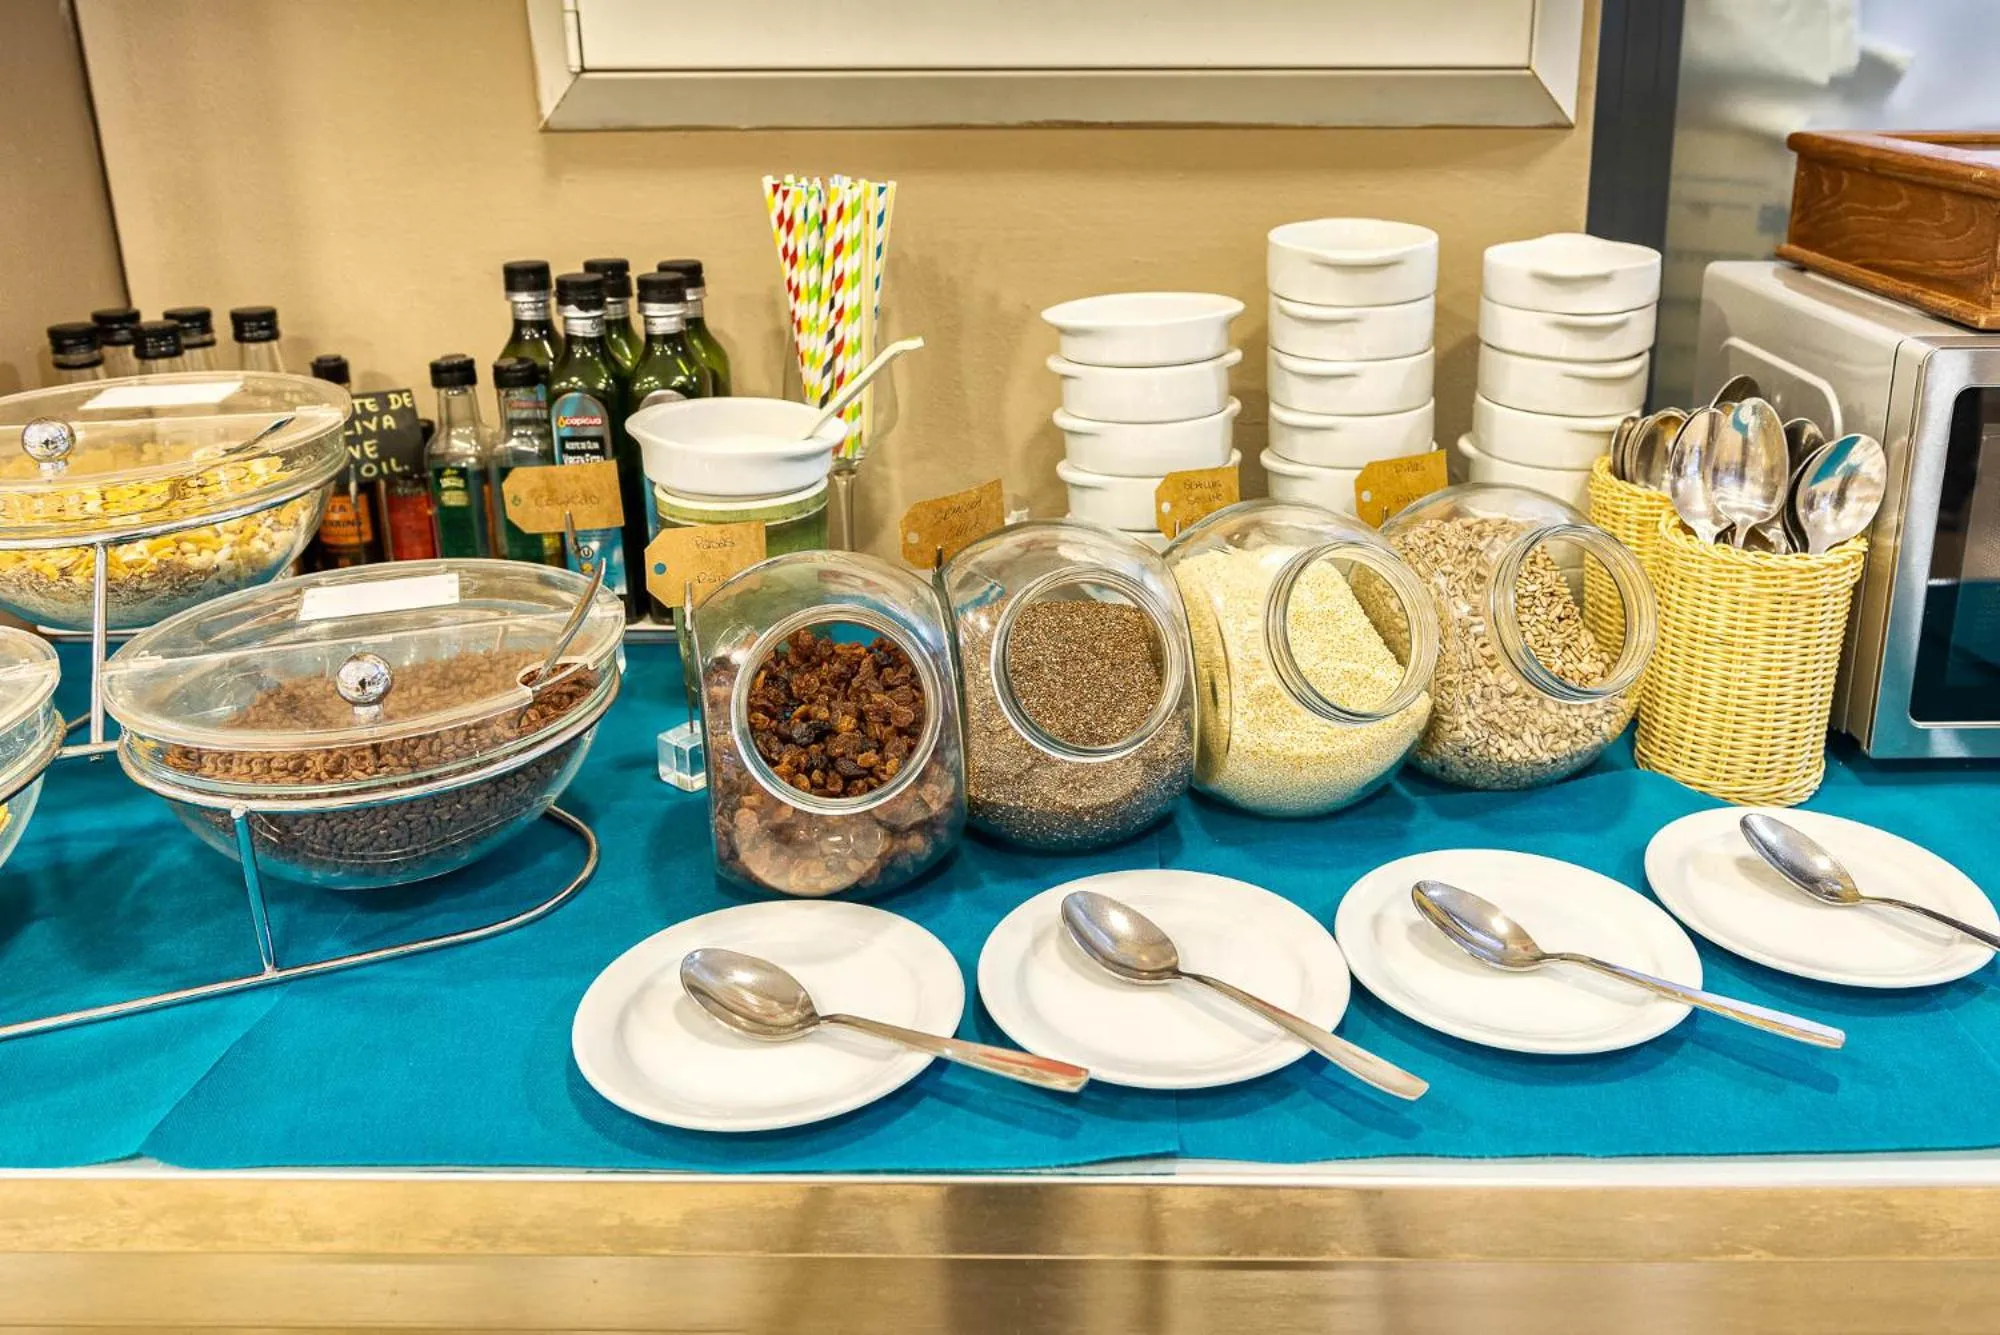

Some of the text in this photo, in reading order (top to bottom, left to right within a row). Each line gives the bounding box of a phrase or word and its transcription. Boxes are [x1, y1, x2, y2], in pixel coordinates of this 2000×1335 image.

[352, 391, 413, 414] TE DE
[344, 414, 397, 435] IVA
[347, 439, 379, 459] VE
